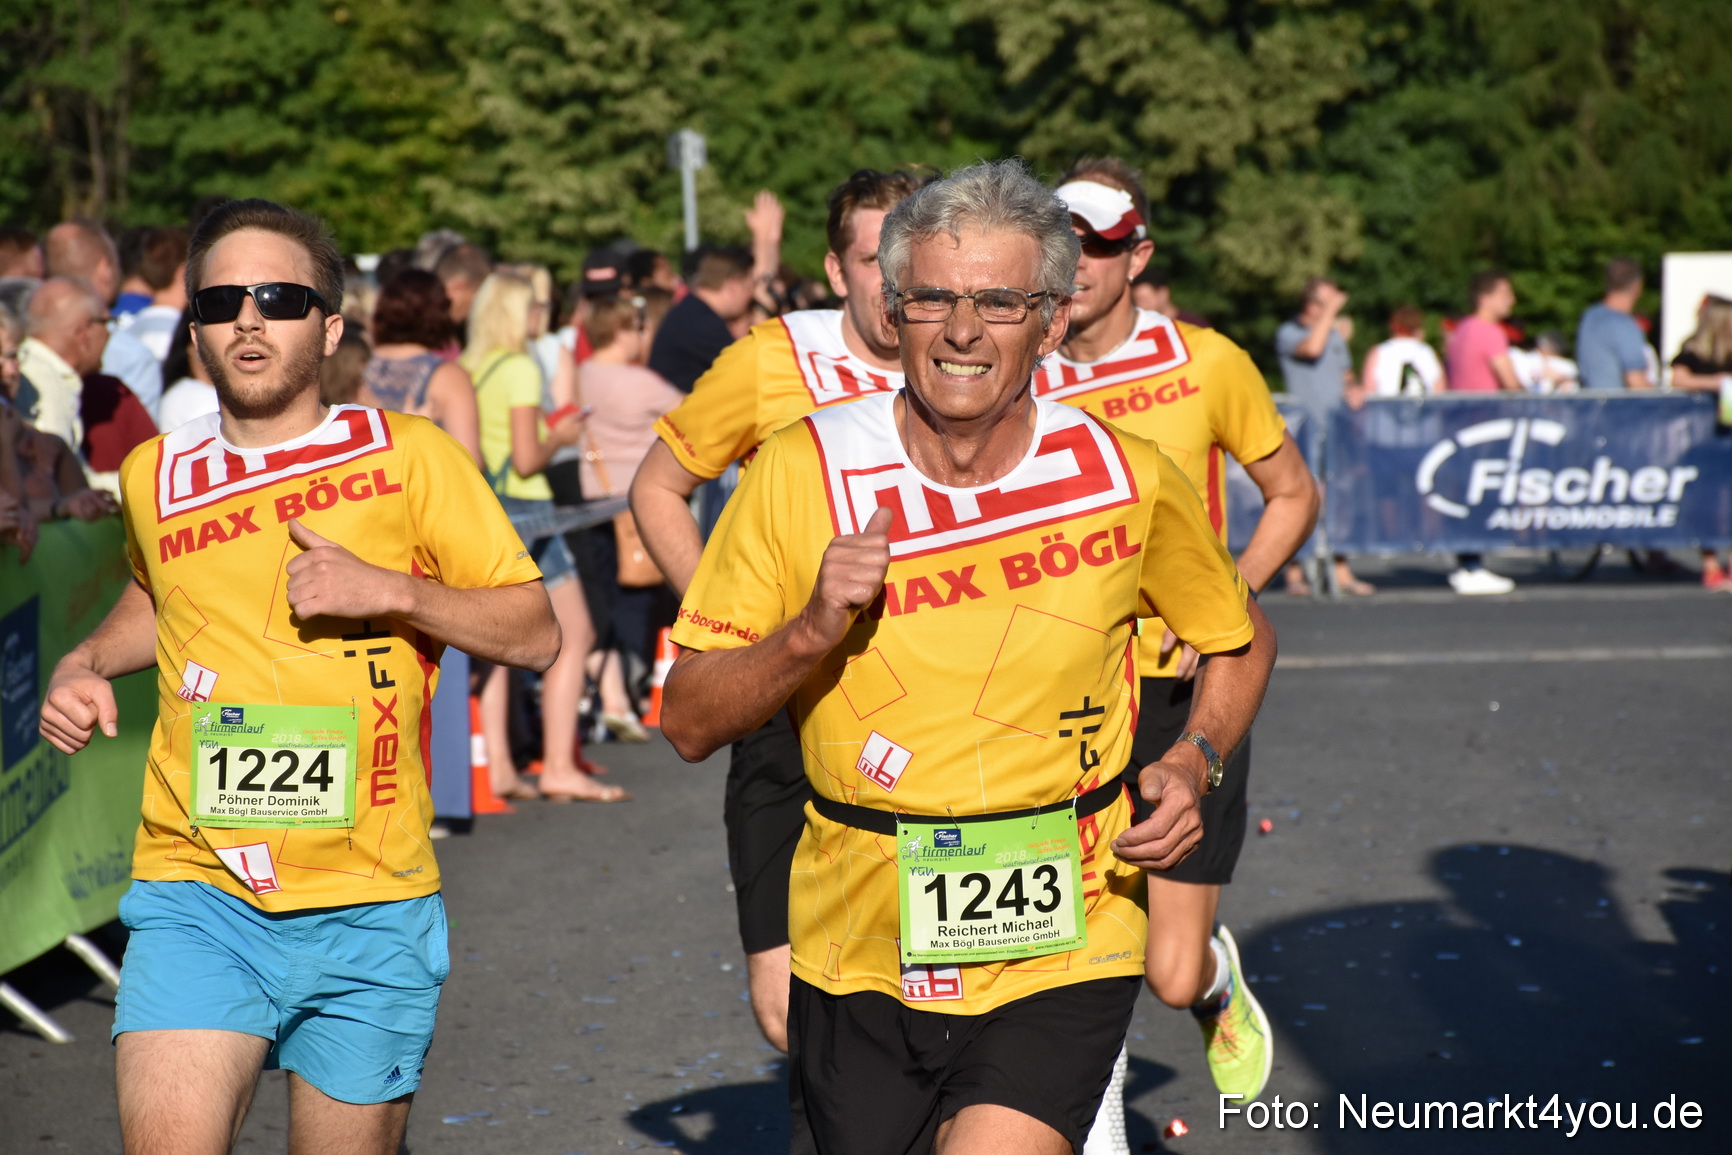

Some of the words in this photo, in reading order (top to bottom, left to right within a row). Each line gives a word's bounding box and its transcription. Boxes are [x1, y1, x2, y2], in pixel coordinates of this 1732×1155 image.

[1102, 377, 1200, 420] BÖGL
[1466, 453, 1699, 505] Fischer
[158, 505, 262, 564] MAX
[273, 467, 402, 524] BÖGL
[1487, 504, 1679, 530] AUTOMOBILE
[1000, 525, 1141, 590] BÖGL
[210, 722, 265, 734] firmenlauf
[271, 733, 302, 743] 2018
[209, 747, 334, 793] 1224
[218, 794, 264, 806] Pöhner
[267, 796, 320, 806] Dominik
[210, 806, 226, 815] Max
[228, 807, 248, 817] Bögl
[250, 808, 299, 816] Bauservice
[301, 808, 328, 816] GmbH
[922, 843, 987, 857] firmenlauf
[995, 850, 1027, 864] 2018
[924, 864, 1062, 922] 1243
[937, 923, 998, 937] Reichert
[1002, 916, 1054, 933] Michael
[930, 940, 950, 948] Max
[953, 937, 975, 950] Bögl
[978, 934, 1030, 947] Bauservice
[1032, 930, 1060, 942] GmbH
